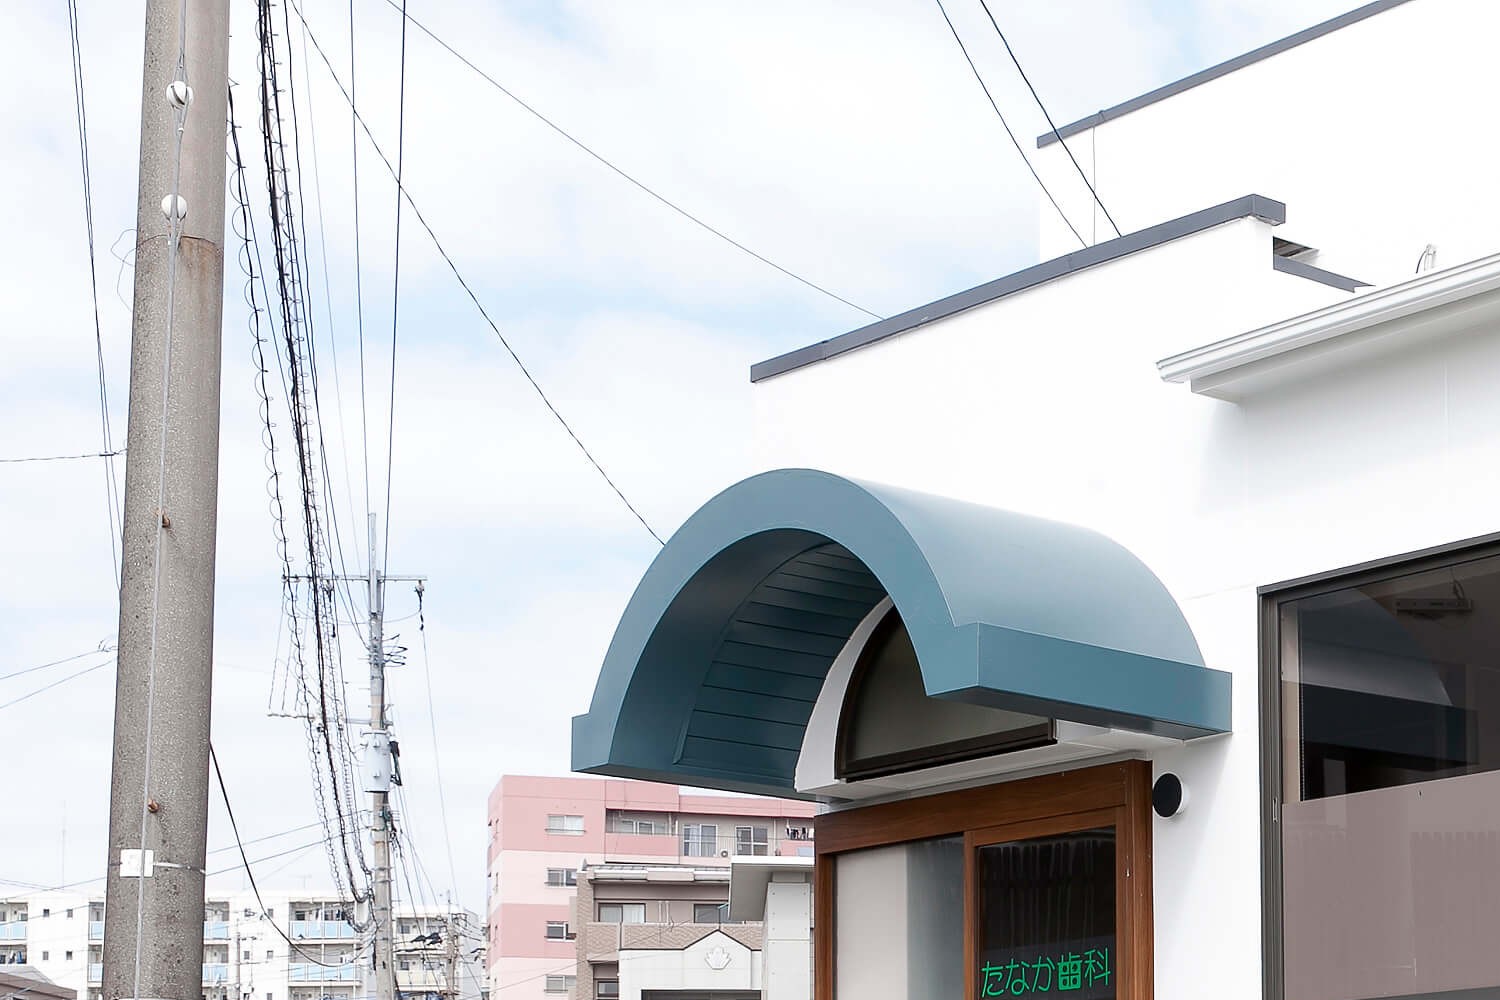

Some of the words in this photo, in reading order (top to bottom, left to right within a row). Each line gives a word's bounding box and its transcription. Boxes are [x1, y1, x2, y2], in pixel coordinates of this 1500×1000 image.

[981, 947, 1111, 998] たなか歯科
